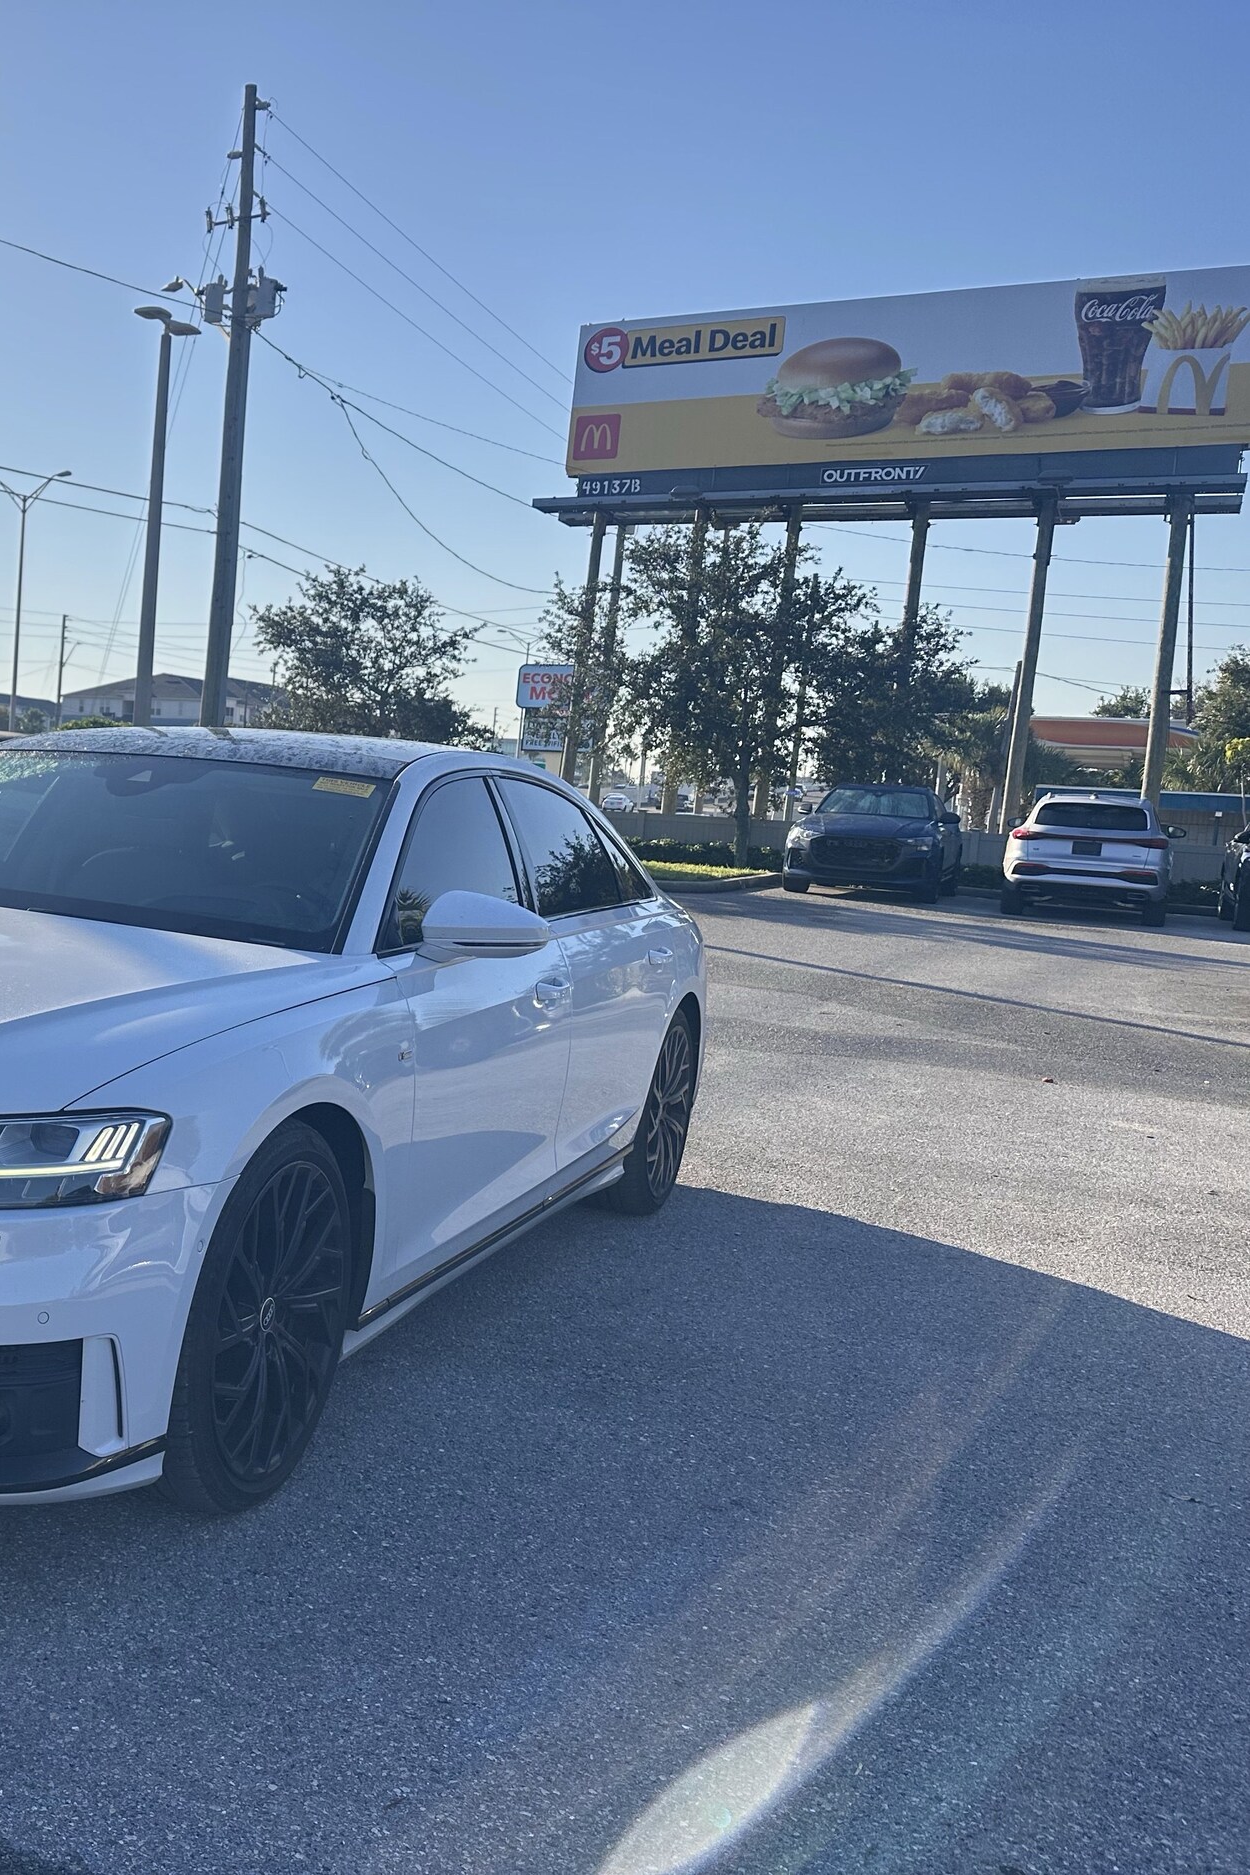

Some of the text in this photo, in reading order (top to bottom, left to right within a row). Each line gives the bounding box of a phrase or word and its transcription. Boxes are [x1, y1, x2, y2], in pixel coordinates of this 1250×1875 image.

[590, 322, 777, 365] $5 Meal Deal
[582, 479, 641, 495] 49137B
